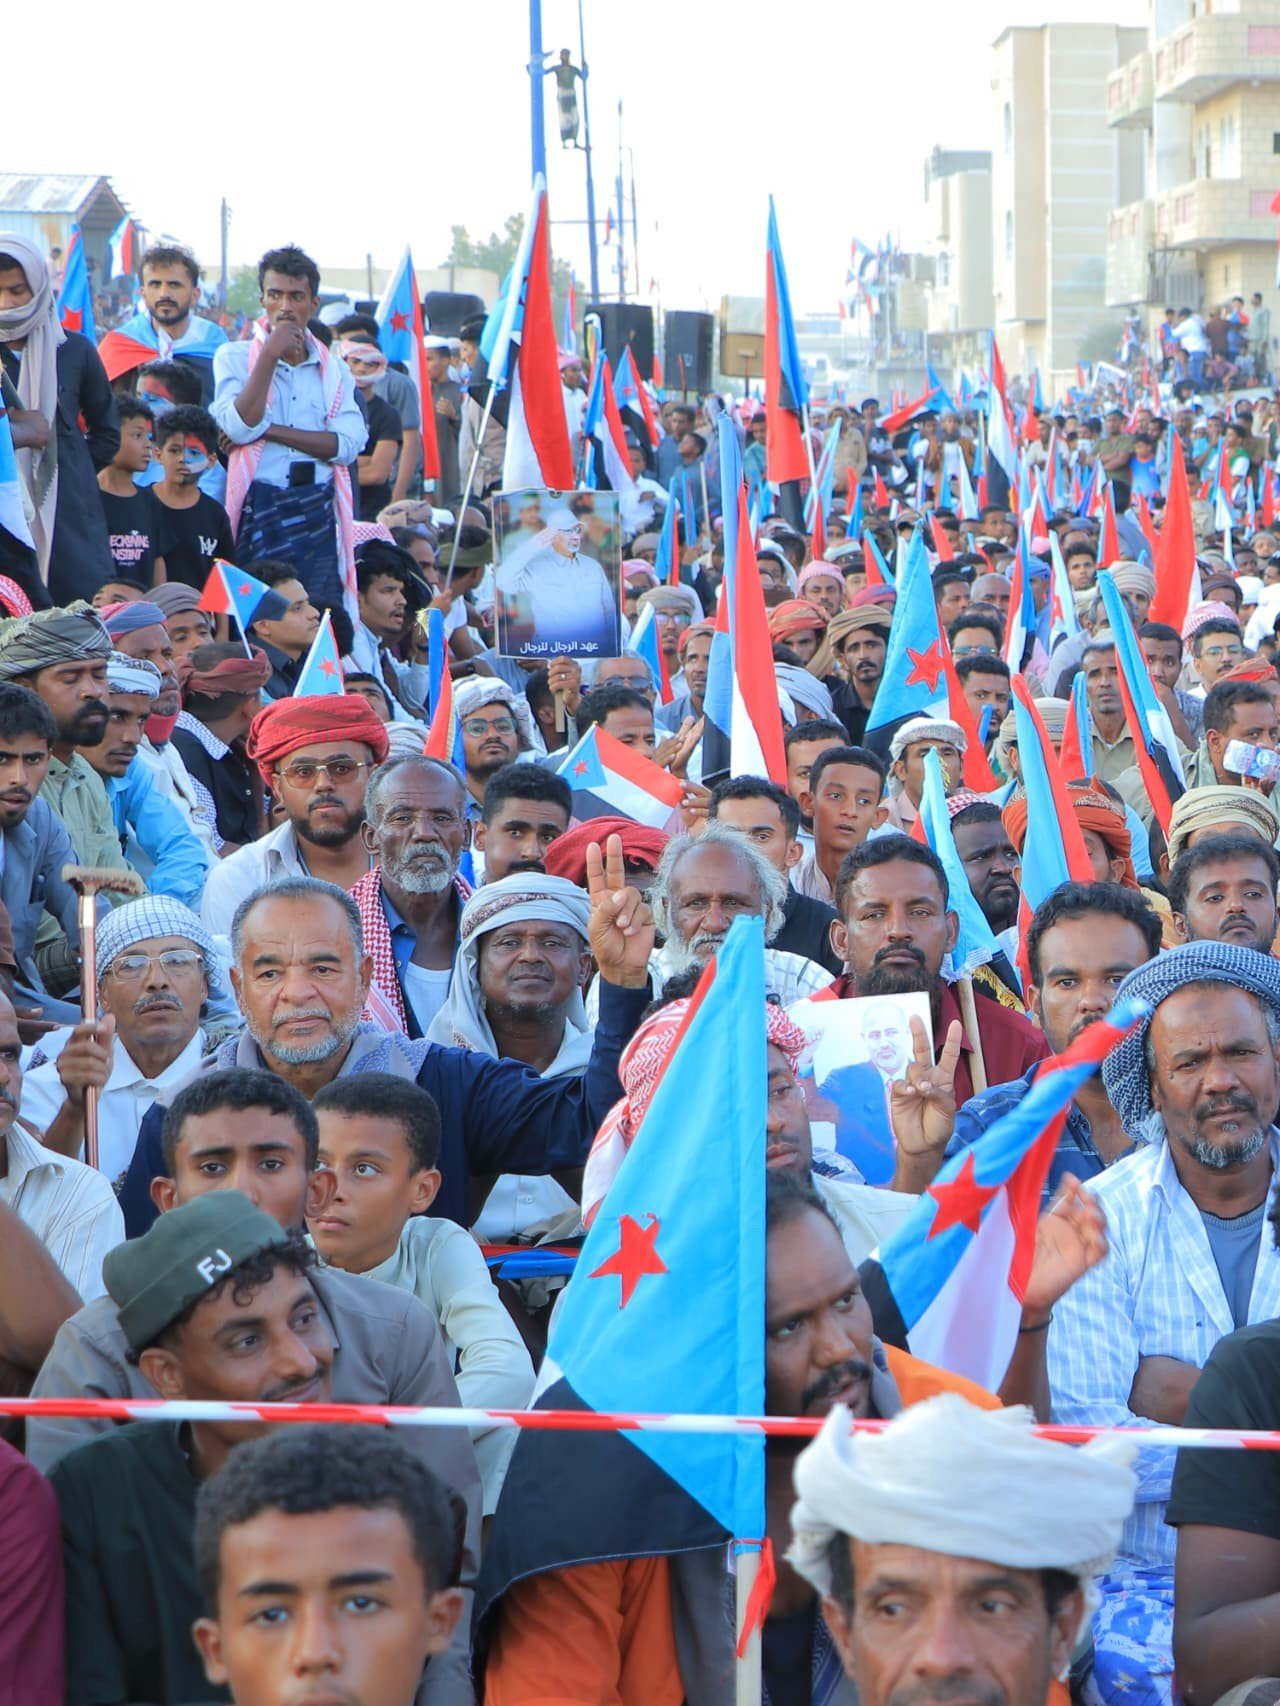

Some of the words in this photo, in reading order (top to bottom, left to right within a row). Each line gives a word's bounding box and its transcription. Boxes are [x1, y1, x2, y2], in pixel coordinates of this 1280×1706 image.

[520, 642, 548, 654] للرجال
[551, 641, 578, 653] الرجال
[580, 642, 599, 652] عهد
[197, 1249, 232, 1284] FJ
